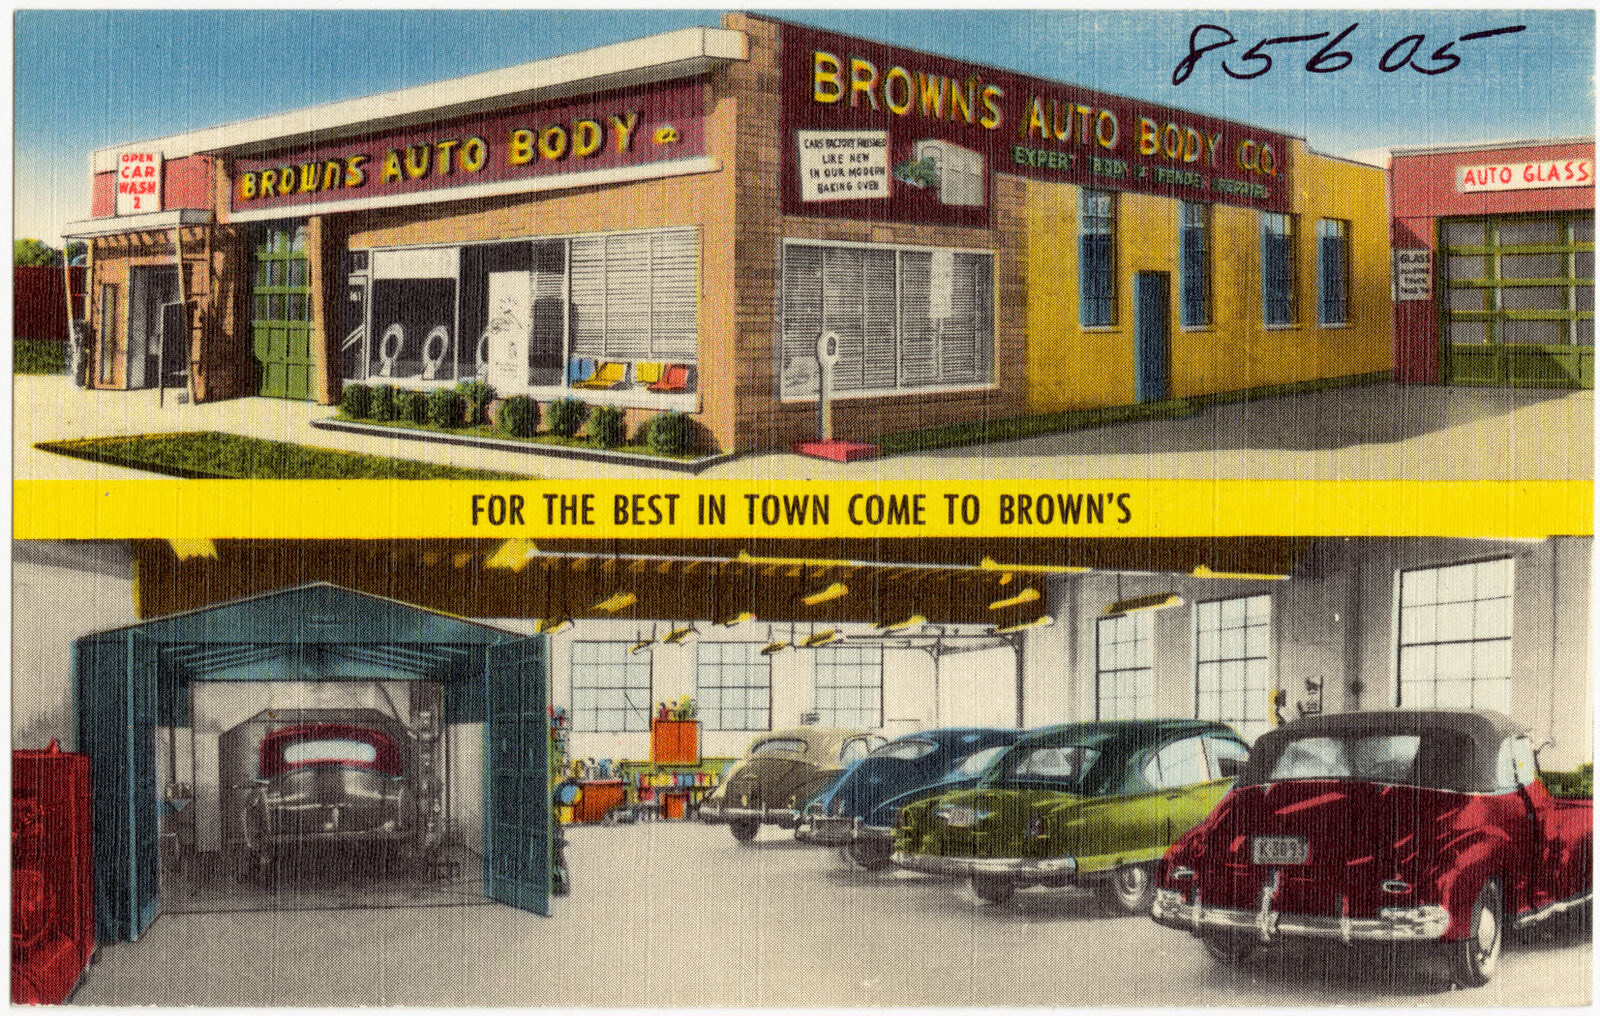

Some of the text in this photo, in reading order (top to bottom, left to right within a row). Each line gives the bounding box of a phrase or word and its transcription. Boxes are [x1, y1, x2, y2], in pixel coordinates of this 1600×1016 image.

[811, 50, 1004, 130] BROWN'S
[1023, 95, 1117, 150] AUTO
[1137, 115, 1221, 169] BODY
[381, 136, 490, 183] AUTO
[509, 111, 643, 165] BODY
[803, 138, 824, 150] CARS
[826, 138, 855, 149] FACTORY
[121, 153, 154, 163] OPEN
[822, 153, 869, 165] LIKE NEW
[121, 165, 155, 179] CAR
[809, 166, 886, 178] IN OUR MODERN
[1013, 145, 1078, 172] EXPERT
[1092, 156, 1130, 180] BODY
[1155, 165, 1210, 191] FENDER
[1463, 161, 1590, 186] AUTO GLASS
[119, 181, 157, 195] WASH
[817, 181, 880, 194] BAKING OVEN
[133, 196, 141, 209] 2
